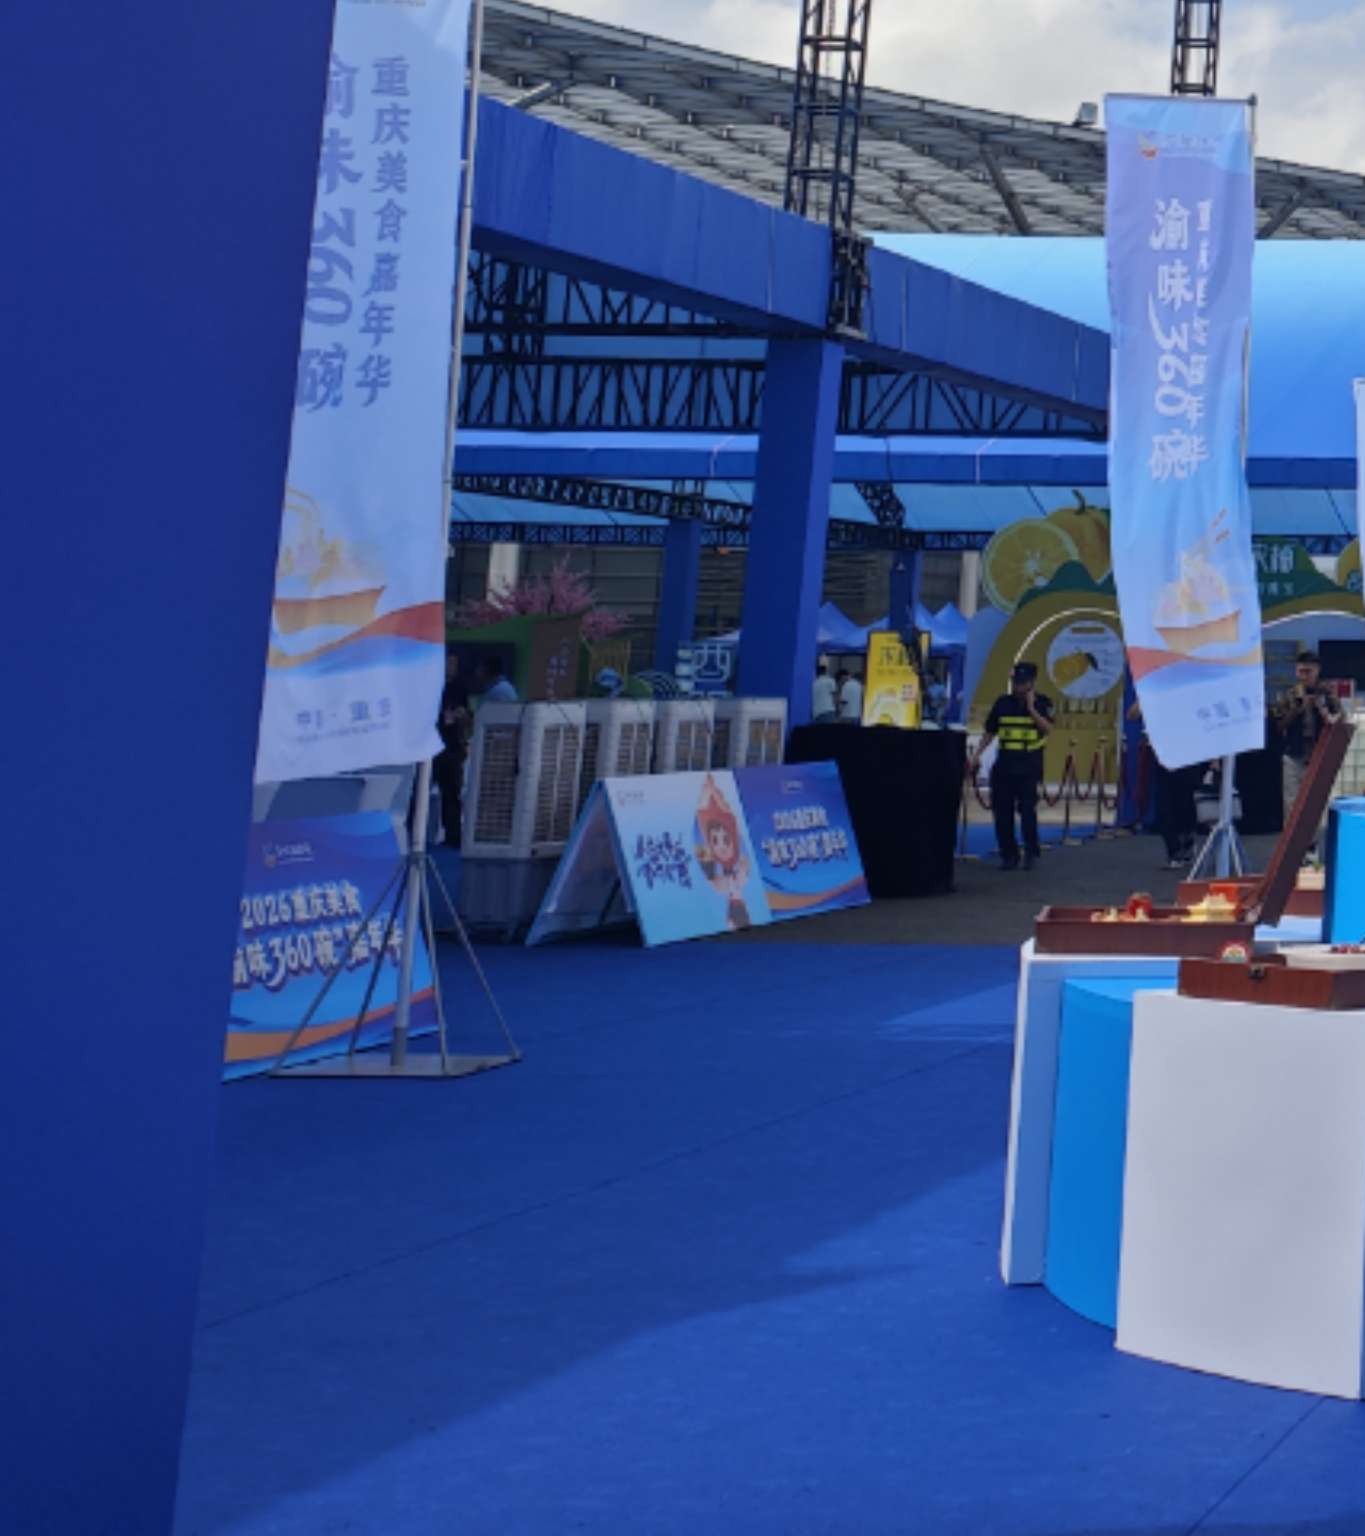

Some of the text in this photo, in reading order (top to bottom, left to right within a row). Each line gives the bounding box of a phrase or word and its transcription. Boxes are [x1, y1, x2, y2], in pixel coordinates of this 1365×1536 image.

[355, 56, 411, 407] 重庆美食嘉年华
[1147, 196, 1196, 483] 渝味360碗
